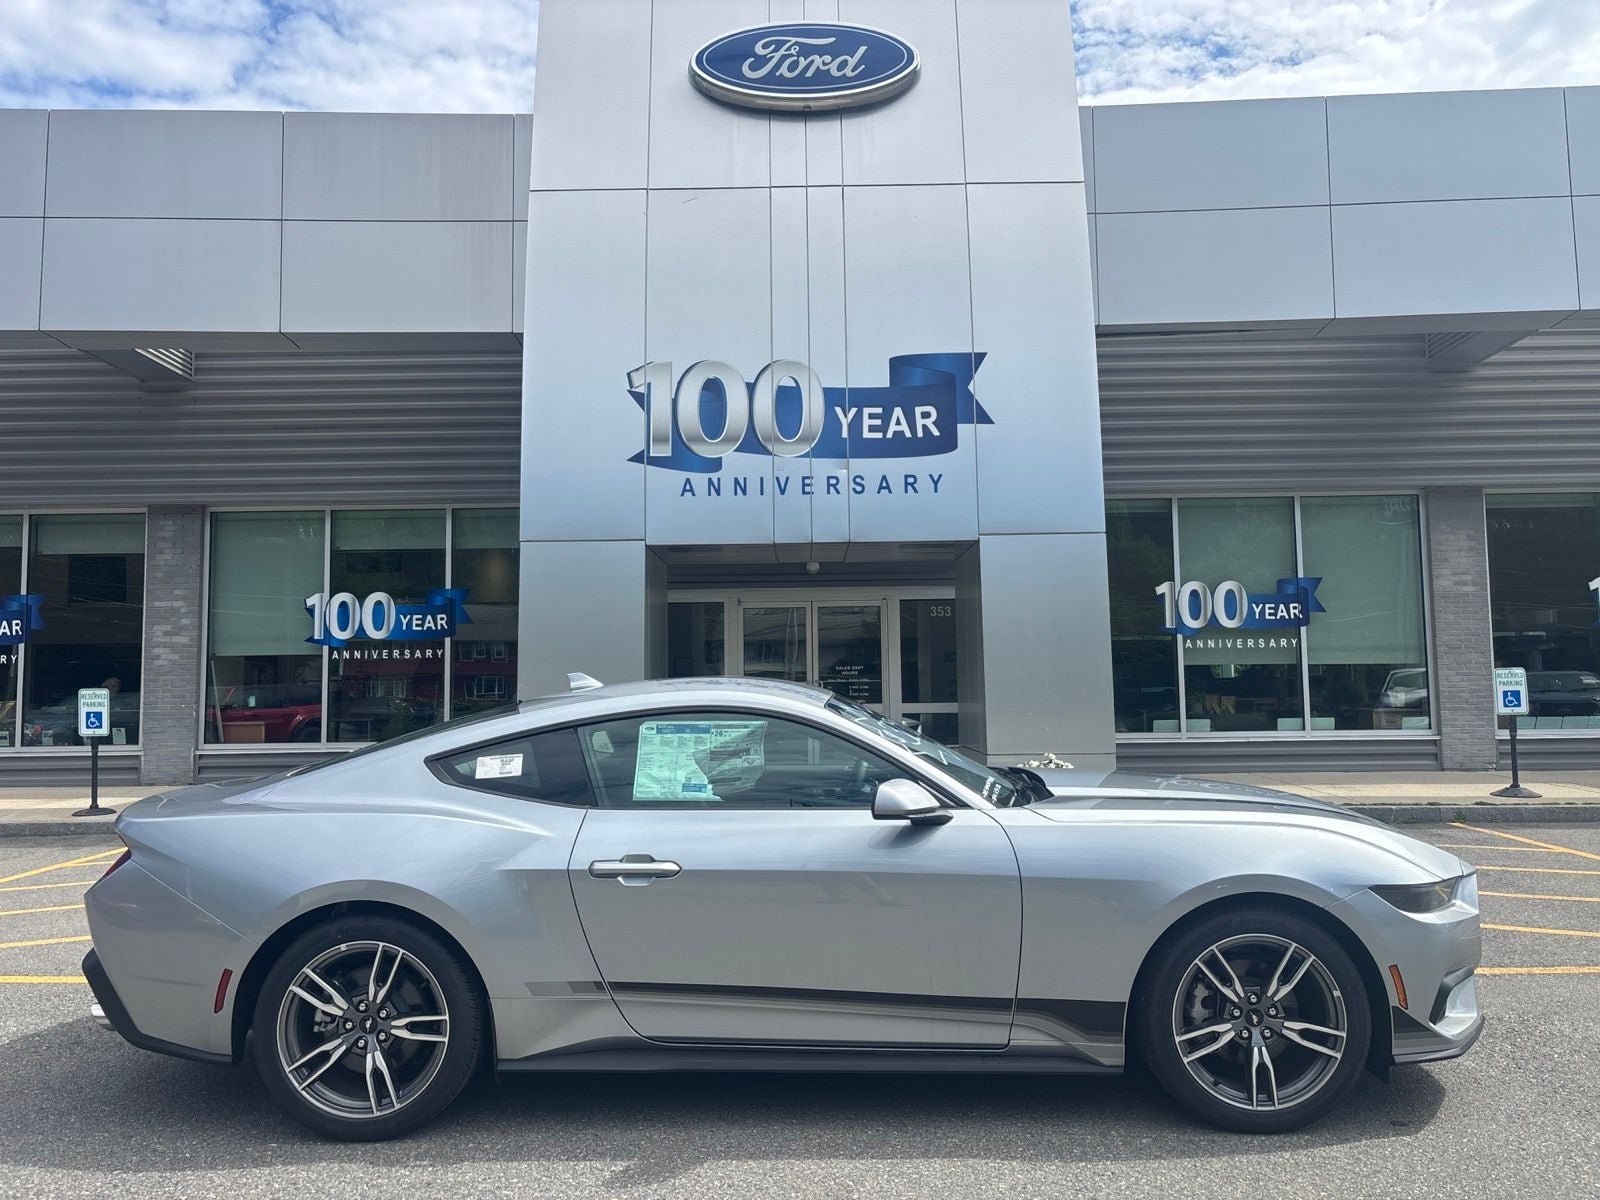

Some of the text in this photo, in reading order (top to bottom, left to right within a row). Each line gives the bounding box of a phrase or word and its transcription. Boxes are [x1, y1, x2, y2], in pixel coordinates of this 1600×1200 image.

[742, 36, 868, 79] Ford
[627, 359, 941, 458] 100 YEAR
[680, 474, 943, 497] ANNIVERSARY
[305, 591, 448, 640] 100 YEAR
[930, 606, 951, 617] 353
[1154, 580, 1303, 629] 100 YEAR
[331, 649, 444, 660] ANNIVERSARY
[1185, 638, 1298, 649] ANNIVERSARY
